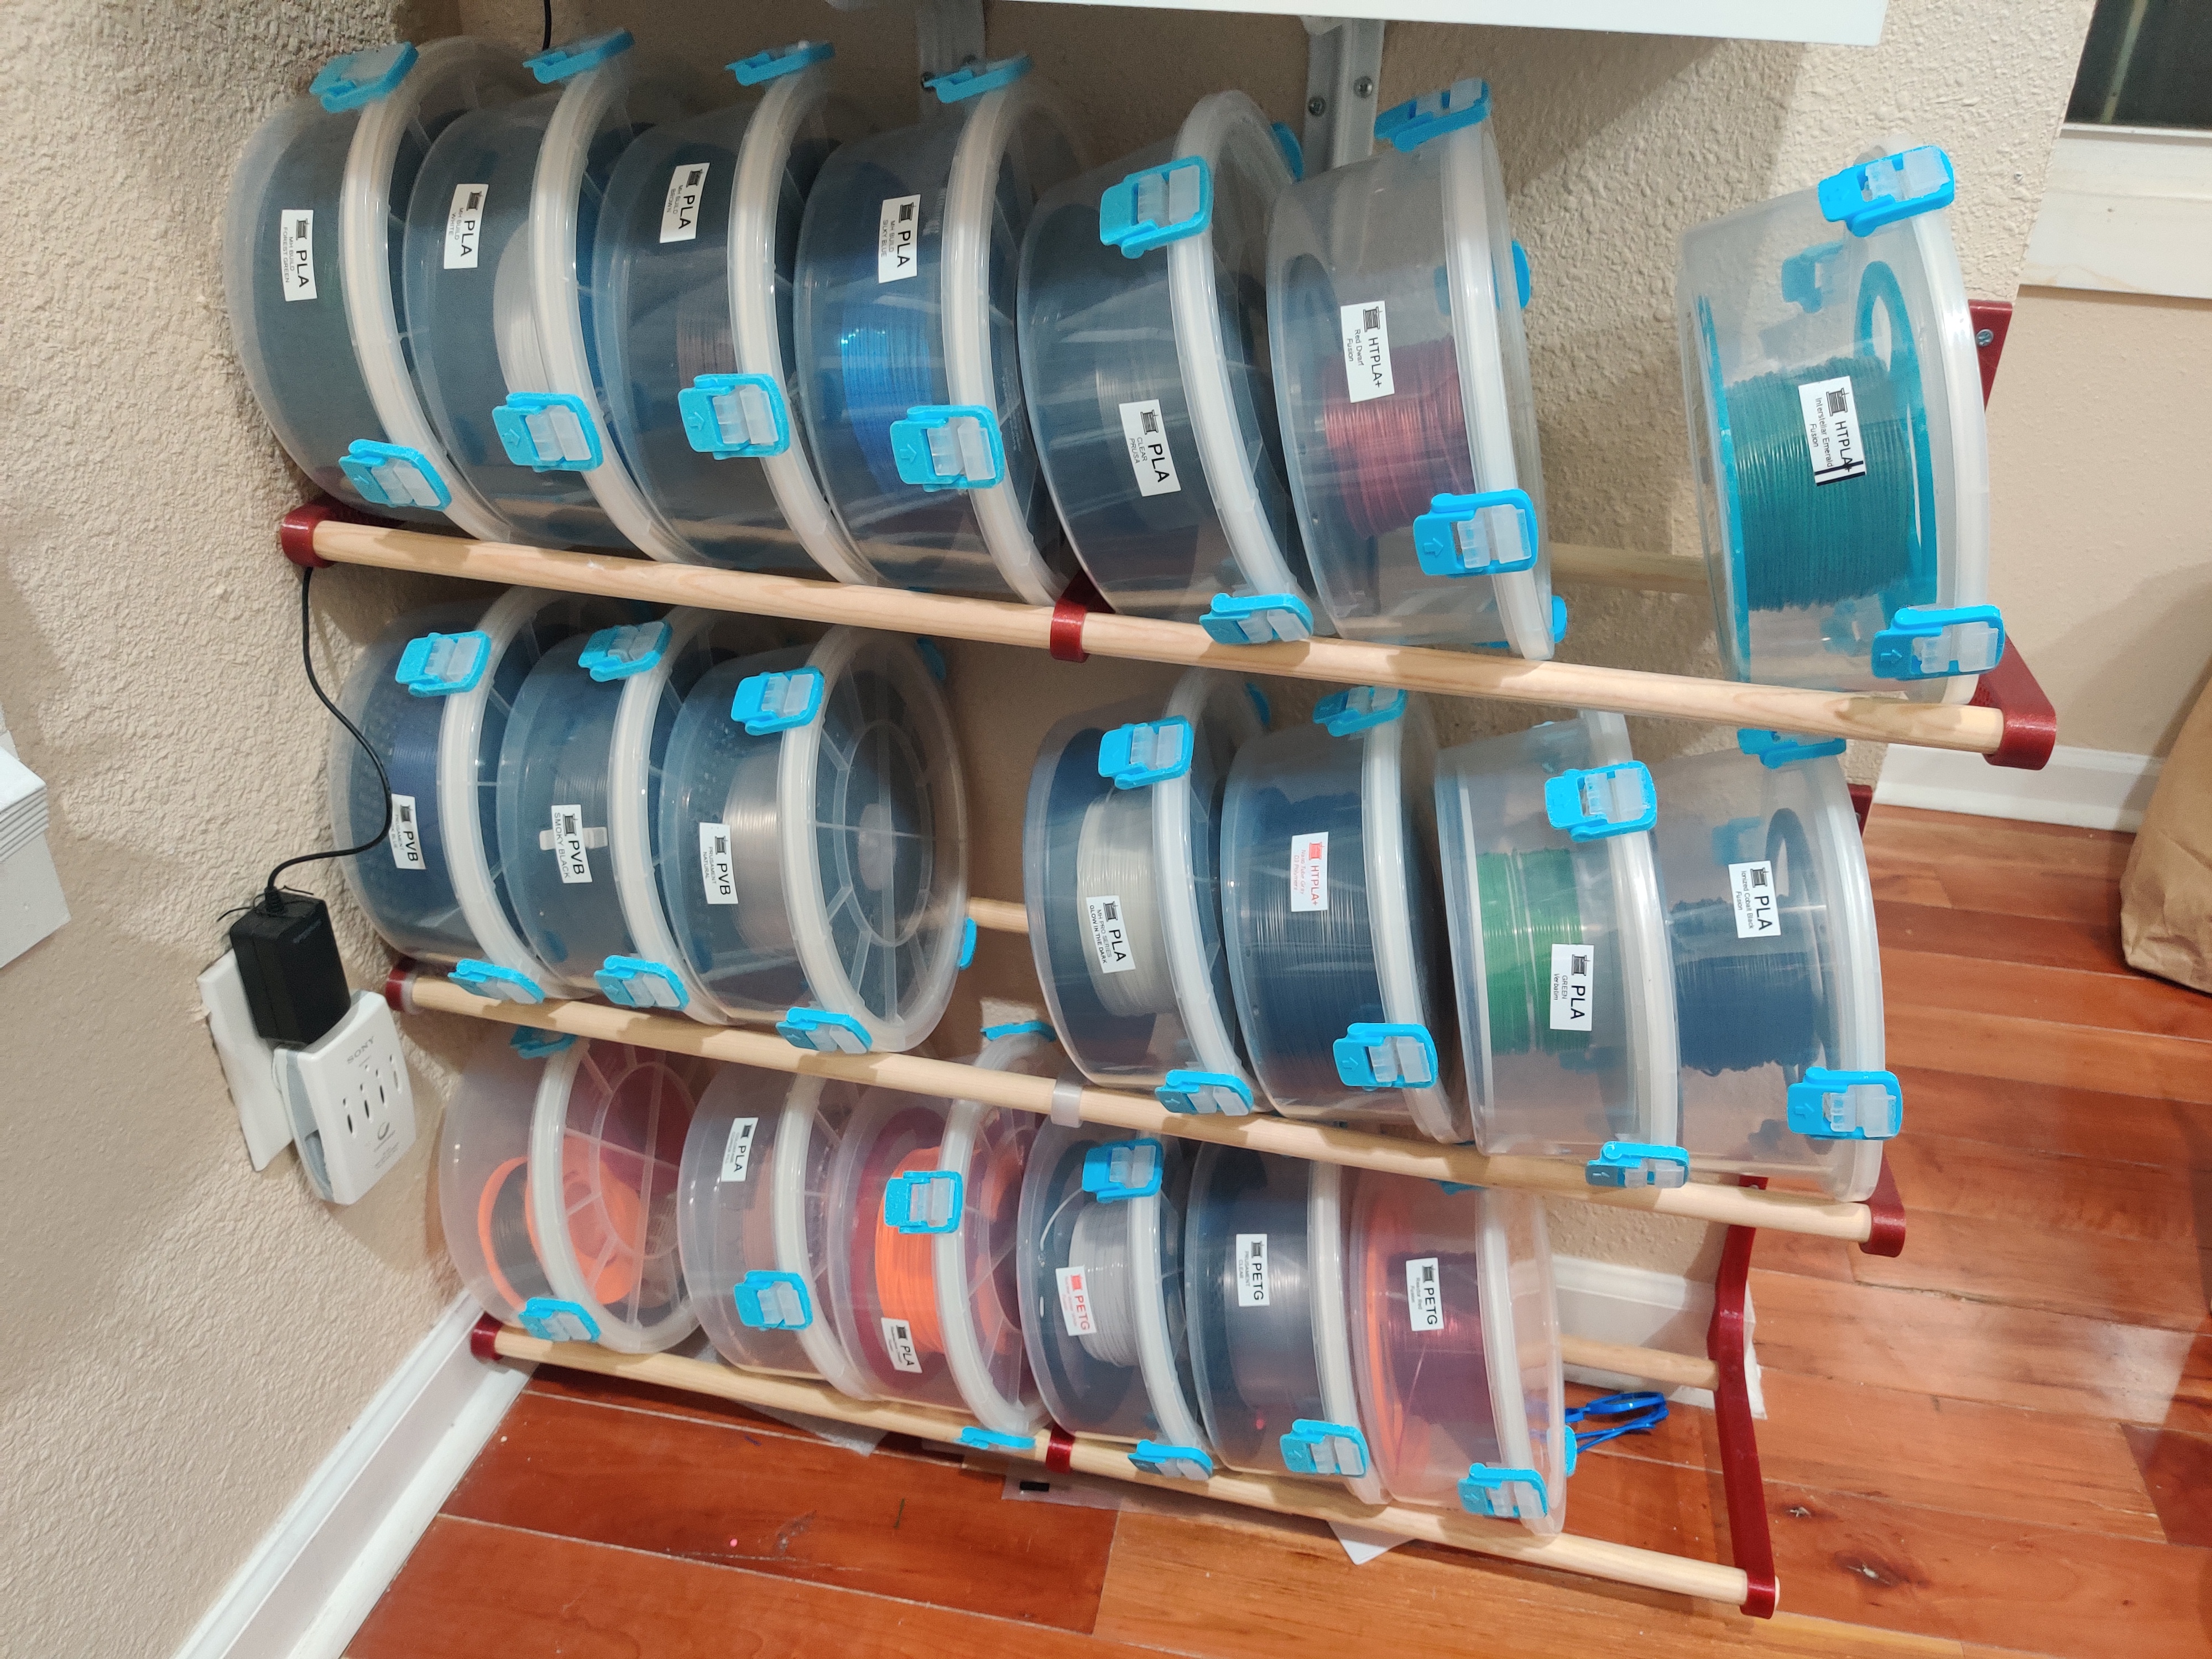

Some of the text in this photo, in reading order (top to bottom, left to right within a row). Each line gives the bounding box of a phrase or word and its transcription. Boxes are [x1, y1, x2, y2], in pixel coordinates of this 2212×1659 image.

[679, 195, 695, 229] PLA
[890, 221, 895, 231] MH
[289, 237, 293, 247] MH
[461, 221, 475, 257] PLA
[897, 231, 911, 268] PLA
[296, 250, 309, 288] PLA
[1369, 337, 1382, 388] HTPLA+
[1137, 437, 1147, 461] CLEAR
[1809, 424, 1818, 447] Fusion
[1815, 398, 1833, 467] Interstellar Emerald
[1129, 438, 1140, 463] PRUSA
[1148, 444, 1170, 482] PLA
[403, 831, 418, 861] PVB
[555, 812, 571, 878] SMOKY BLACK
[568, 841, 584, 874] PVB
[708, 847, 717, 884] PRUSAMENT
[717, 863, 731, 895] PVB
[1311, 865, 1319, 905] HTPLA+
[1755, 896, 1773, 930] PLA
[1097, 910, 1103, 919] MH
[1103, 936, 1112, 957] SERIES
[1109, 930, 1126, 961] PLA
[1099, 947, 1107, 963] DARK
[1571, 985, 1585, 1019] PLA
[347, 1035, 374, 1064] SONY
[734, 1146, 747, 1172] PLA
[1252, 1263, 1264, 1300] PETG
[1074, 1296, 1090, 1330] PETG
[1424, 1288, 1437, 1324] PETG
[901, 1345, 915, 1365] PLA
